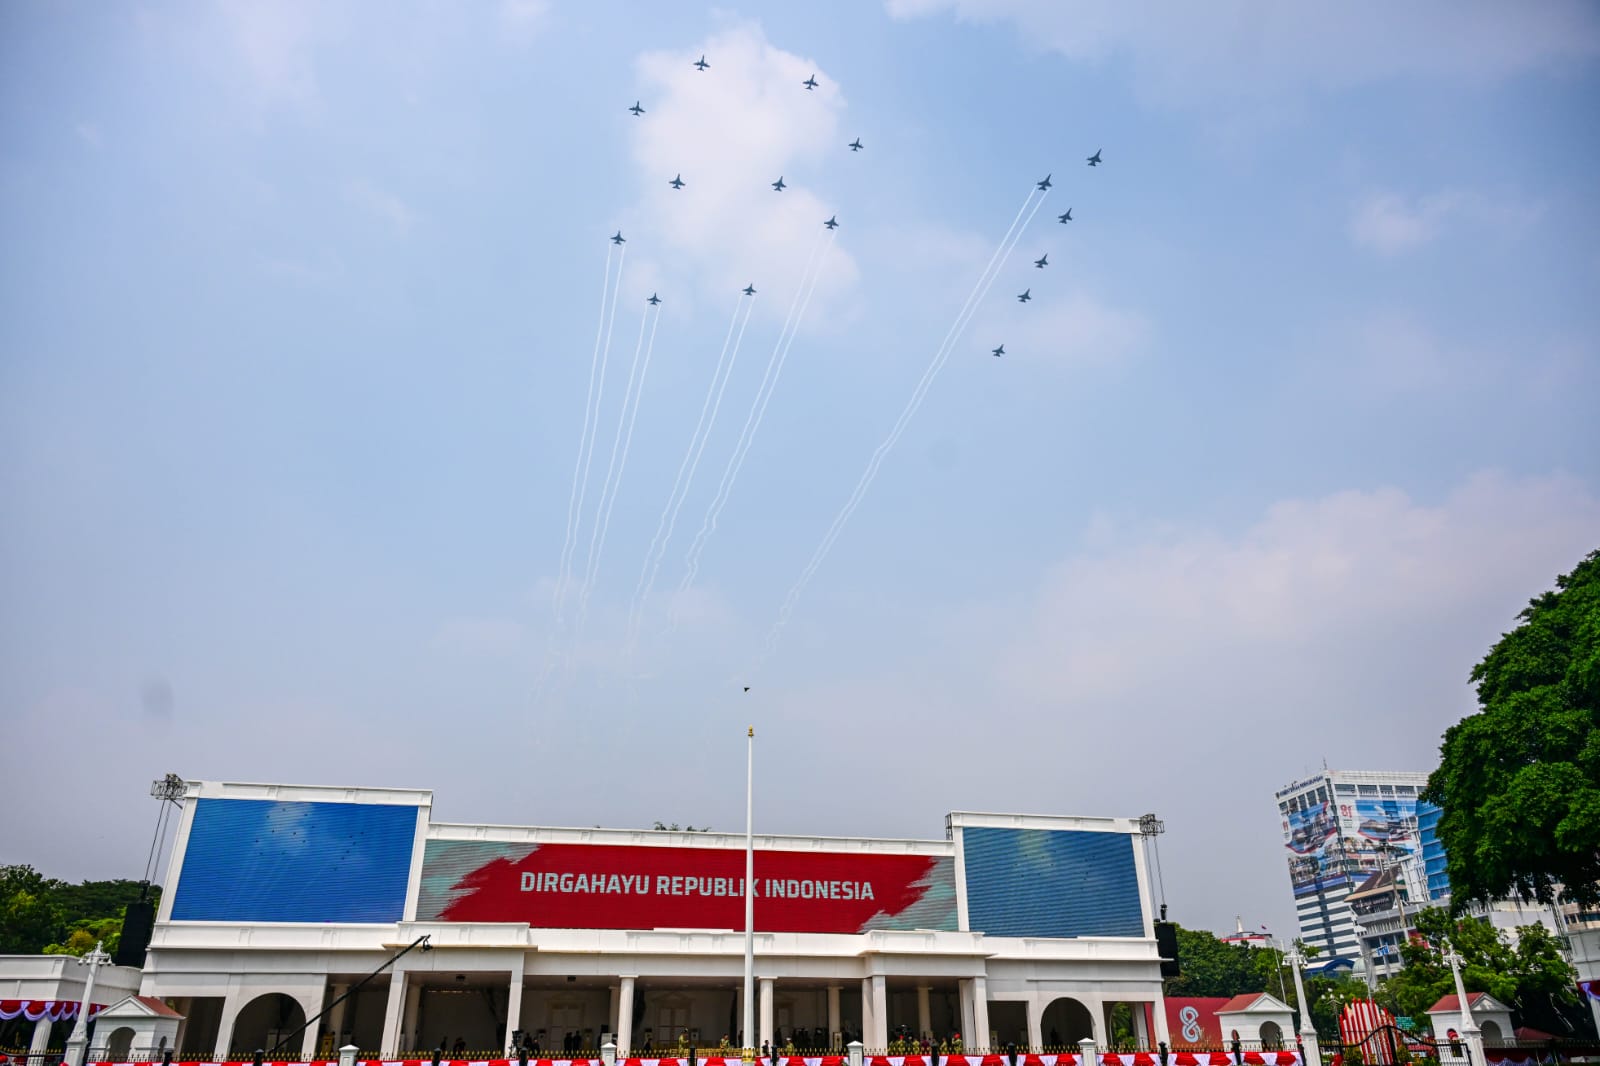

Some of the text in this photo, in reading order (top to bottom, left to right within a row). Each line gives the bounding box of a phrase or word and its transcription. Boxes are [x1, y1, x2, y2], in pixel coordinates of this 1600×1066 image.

[520, 872, 875, 901] DIRGAHAYU REPUBLIK INDONESIA
